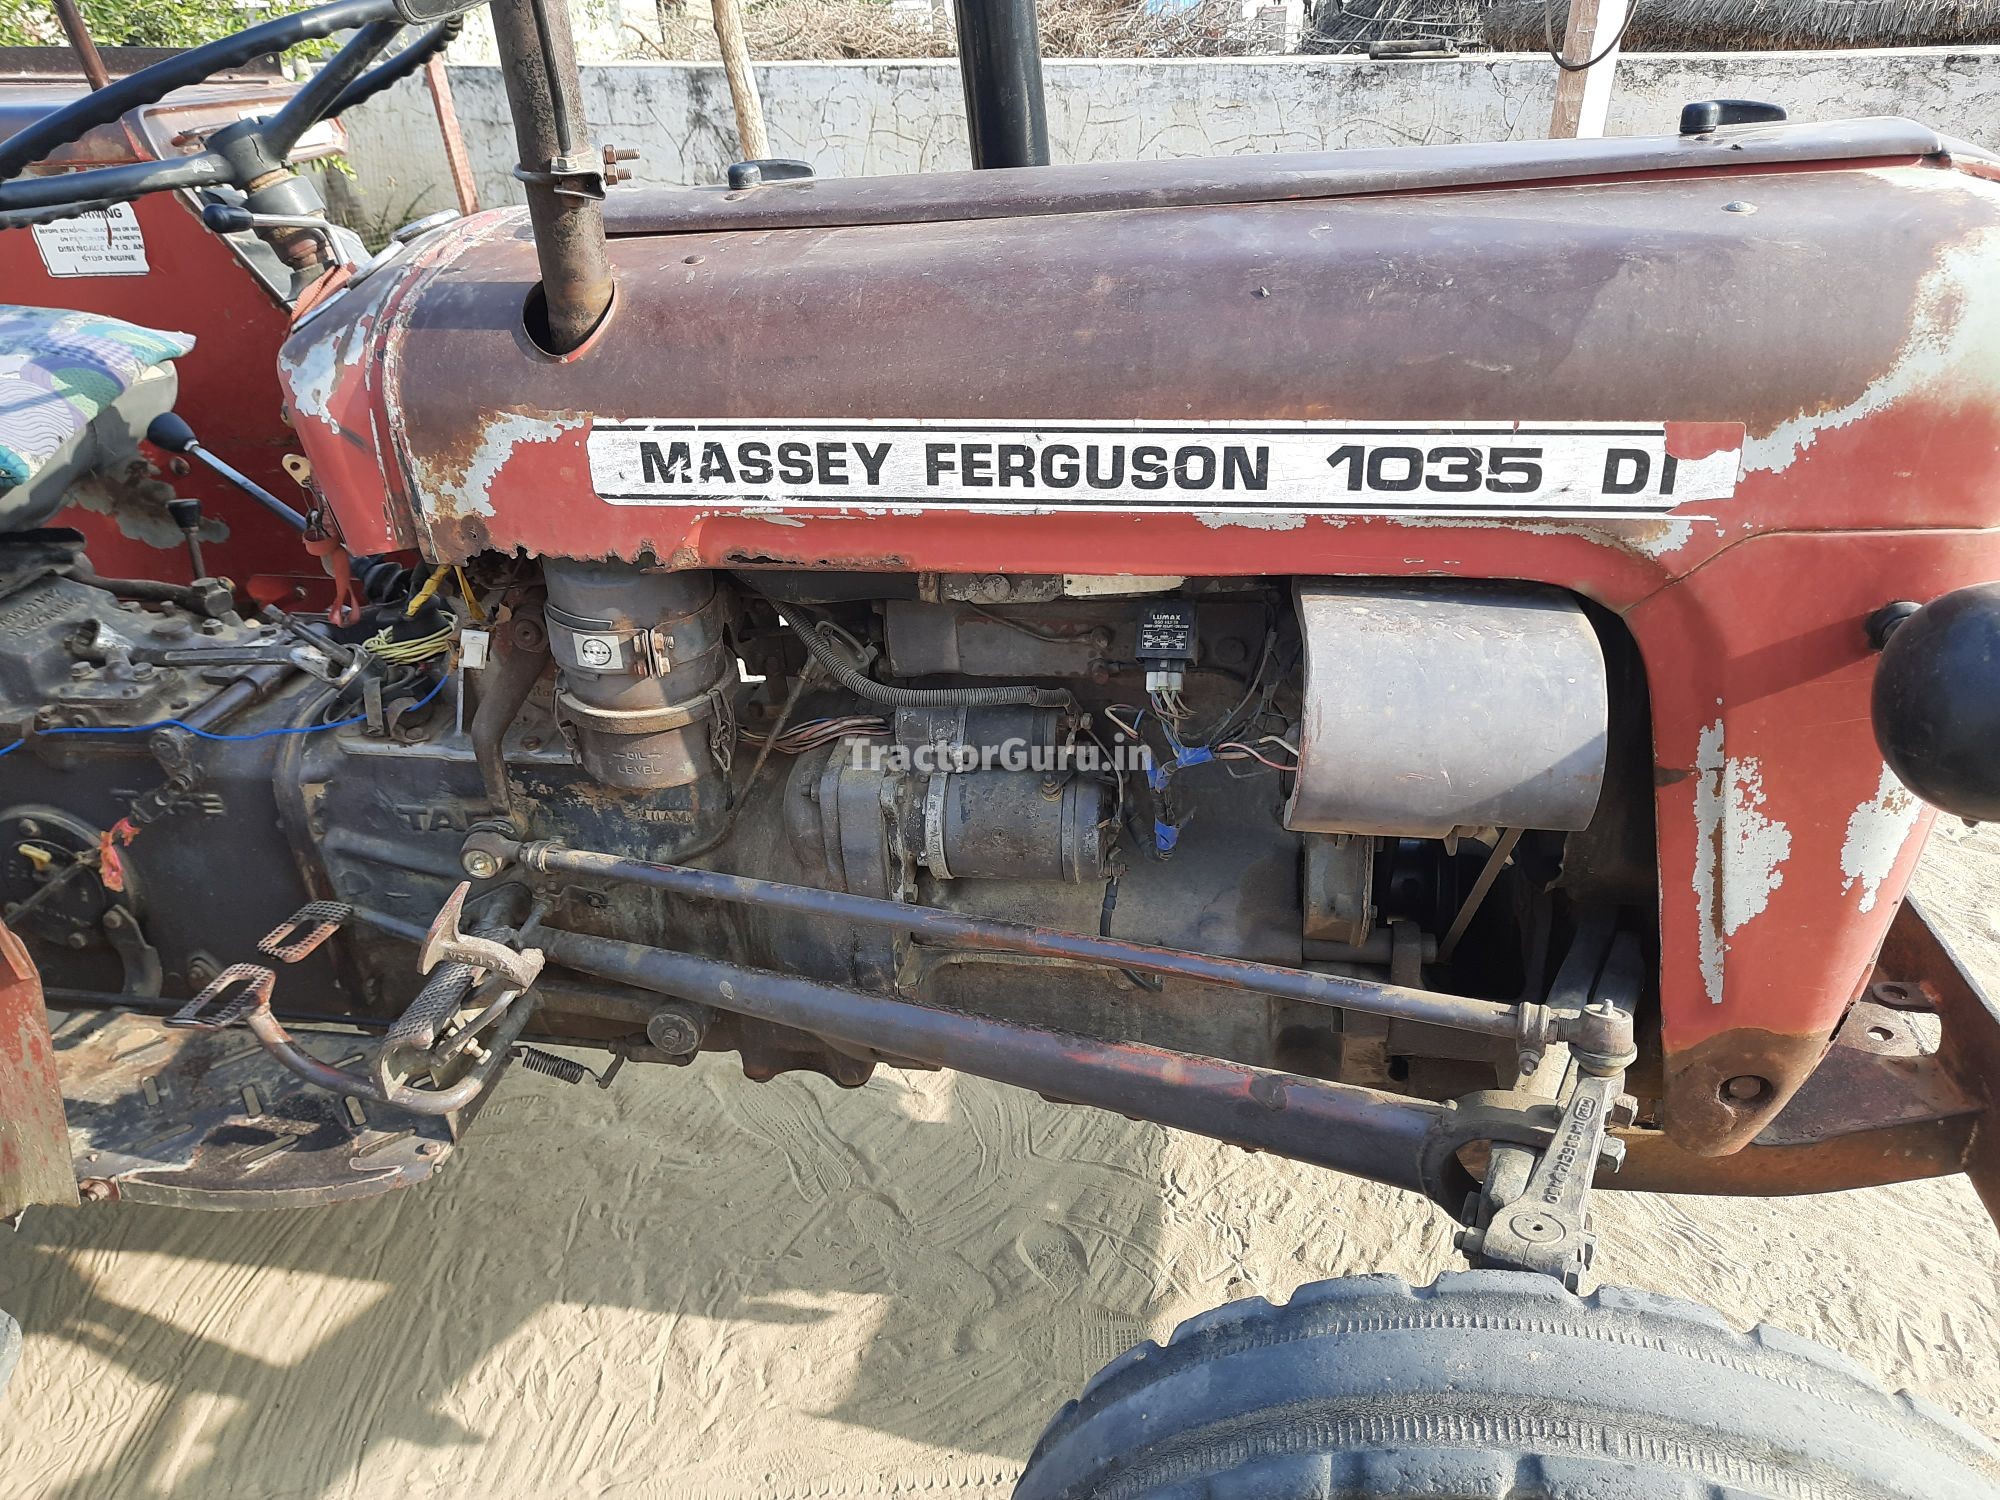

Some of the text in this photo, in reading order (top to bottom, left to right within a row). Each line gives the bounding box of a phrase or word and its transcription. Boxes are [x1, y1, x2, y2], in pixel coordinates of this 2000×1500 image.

[82, 254, 137, 262] STOP ENGINE
[638, 441, 1679, 496] MASSEY FERGUSON 1035 DI
[626, 751, 648, 761] OIL
[617, 760, 663, 775] LEVEL
